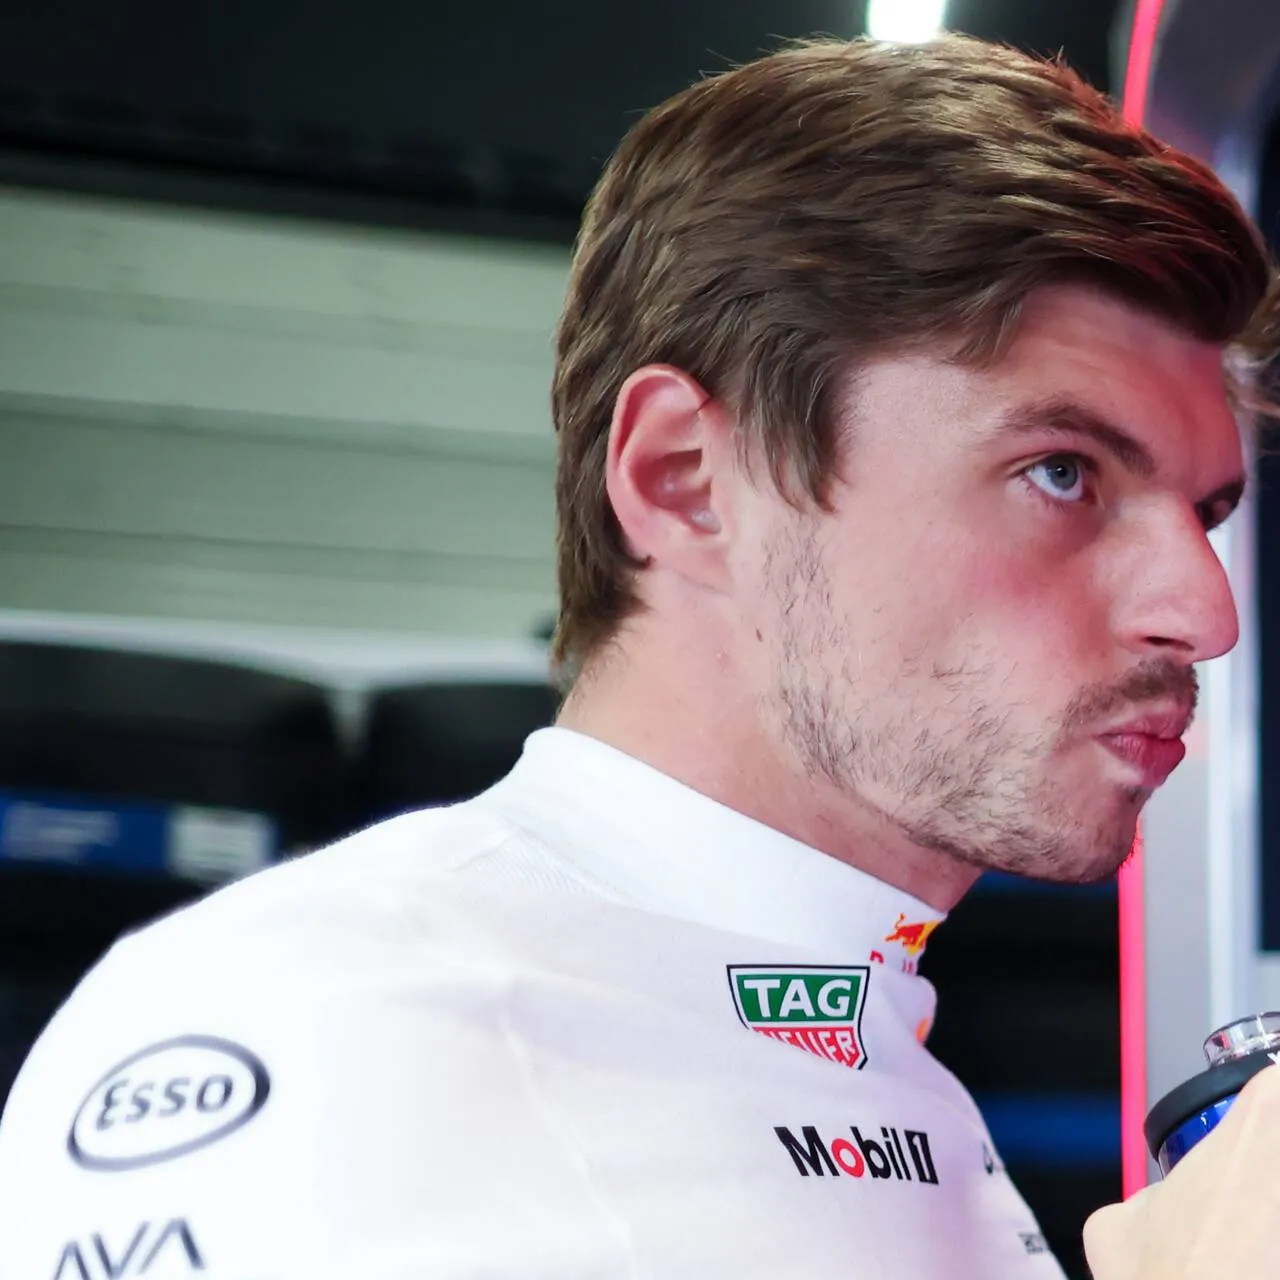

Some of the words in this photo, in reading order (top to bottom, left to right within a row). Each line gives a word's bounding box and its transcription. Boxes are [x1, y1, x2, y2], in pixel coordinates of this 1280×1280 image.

[743, 979, 852, 1018] TAG
[774, 1126, 912, 1181] Mobil
[904, 1129, 939, 1185] 1
